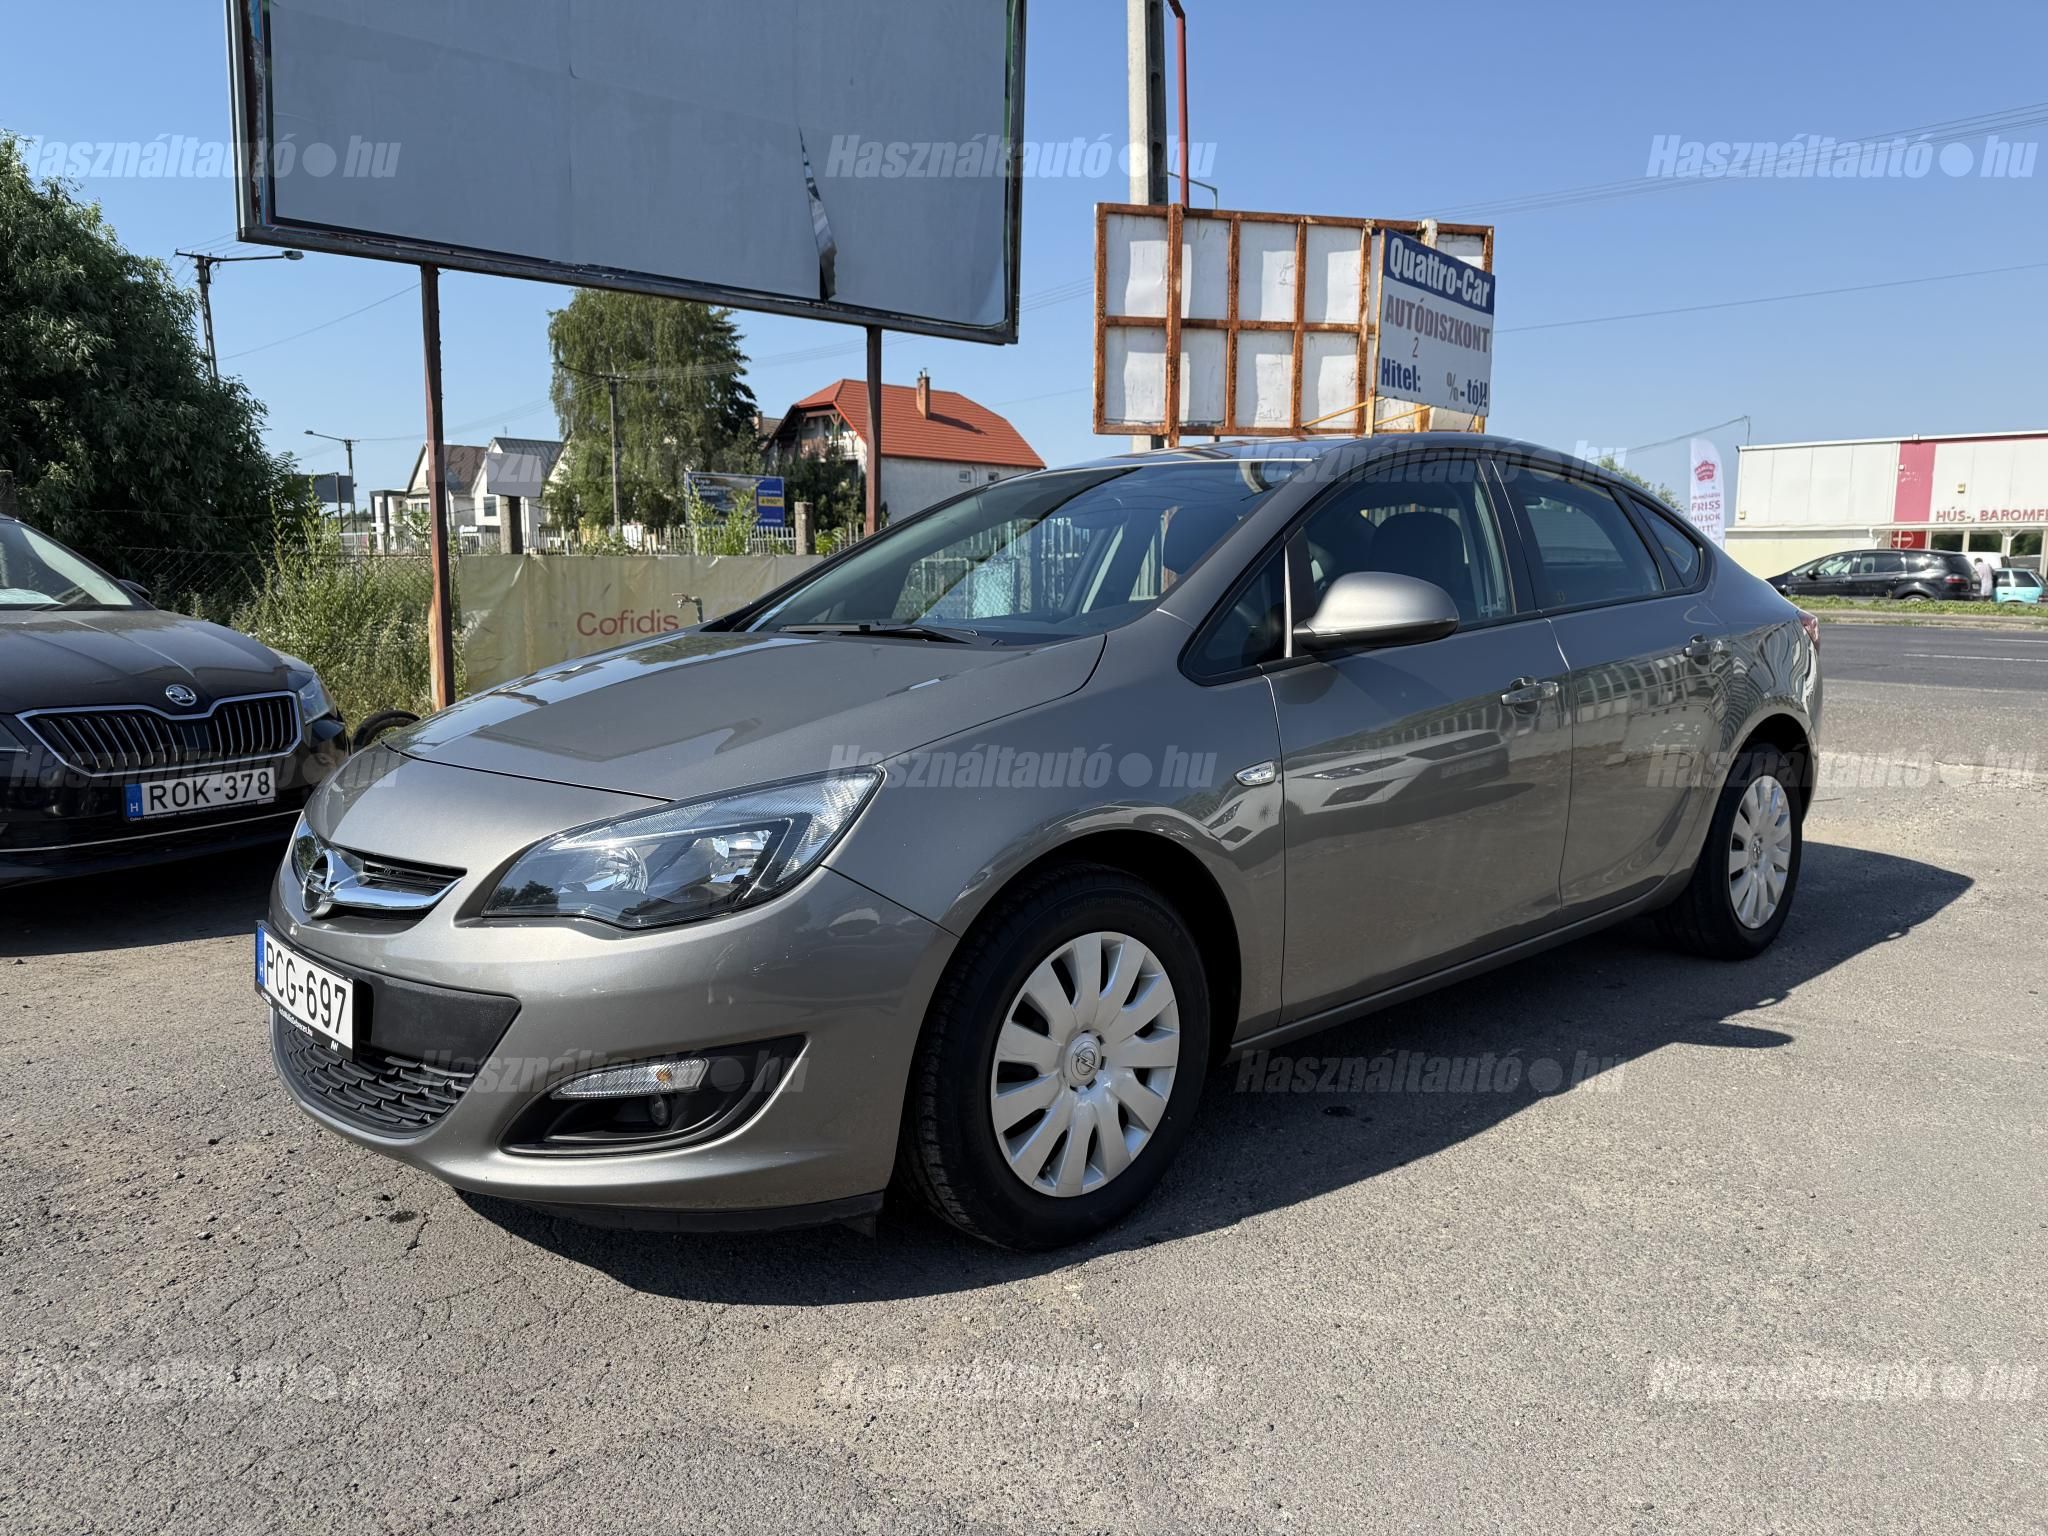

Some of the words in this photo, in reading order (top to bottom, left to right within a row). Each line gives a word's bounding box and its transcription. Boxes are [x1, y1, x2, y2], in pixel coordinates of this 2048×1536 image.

[1389, 237, 1491, 308] Quattro-Car
[1385, 294, 1490, 353] AUTÓDISZKONT
[1381, 357, 1421, 393] Hitel:
[1691, 501, 1720, 512] FRISS
[577, 609, 679, 636] Cofidis
[130, 802, 139, 813] H
[149, 771, 271, 811] ROK-378
[266, 941, 347, 1035] PCG-697
